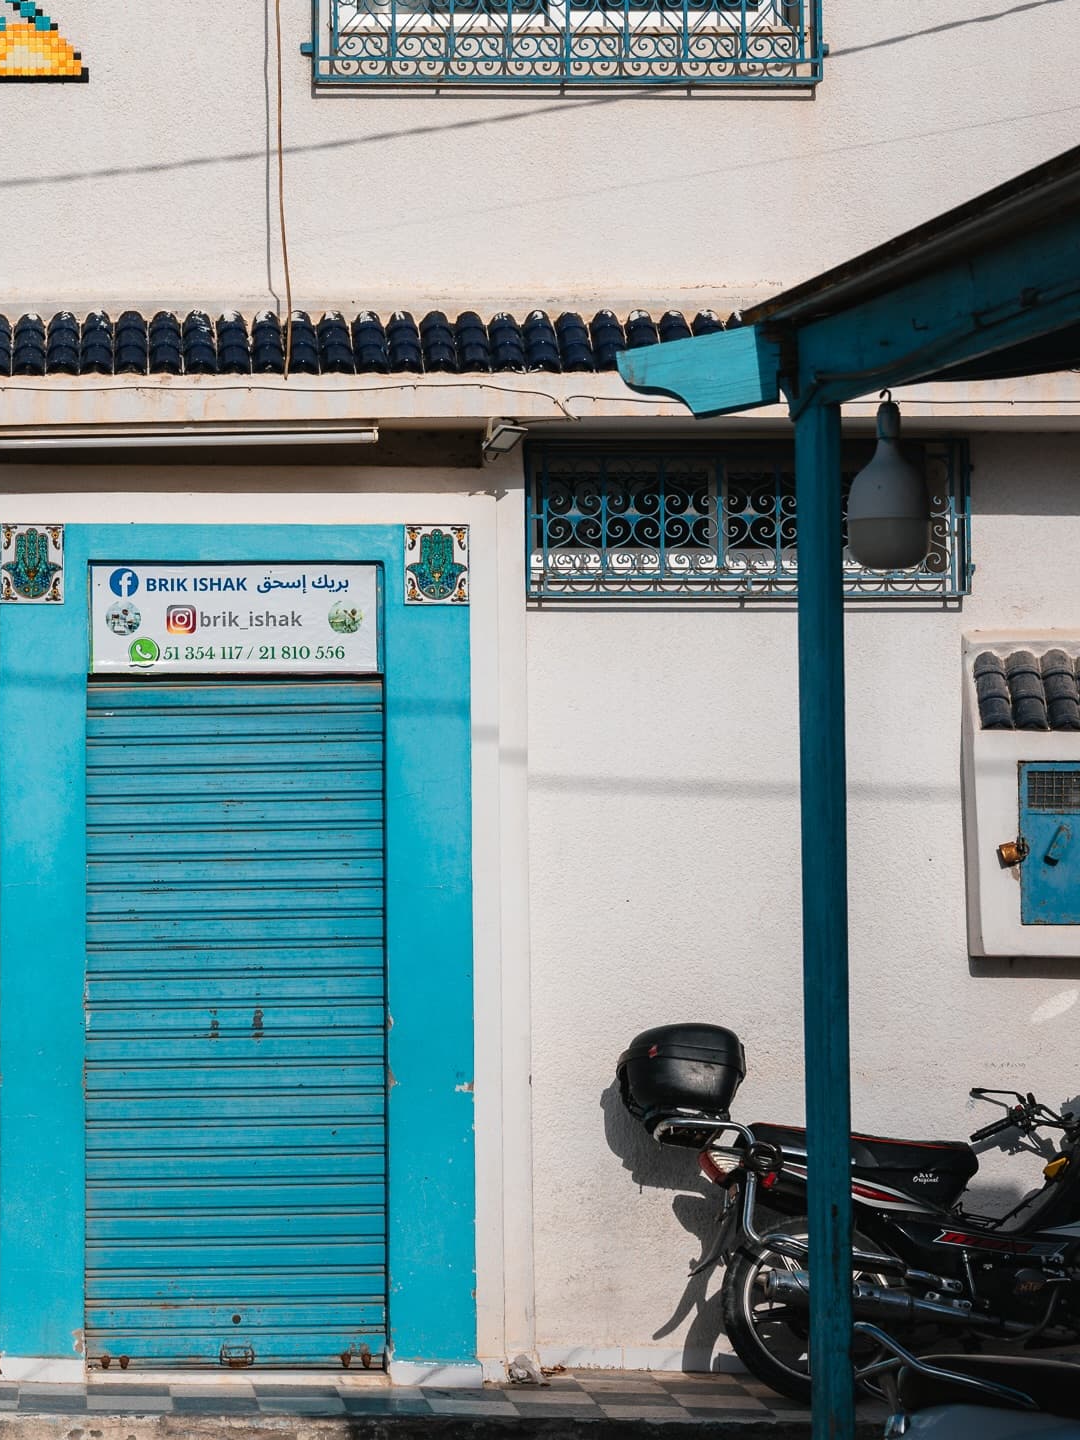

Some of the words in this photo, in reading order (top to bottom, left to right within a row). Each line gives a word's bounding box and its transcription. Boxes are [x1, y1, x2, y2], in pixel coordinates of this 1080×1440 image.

[146, 578, 188, 592] BRIK
[193, 577, 247, 592] ISHAK
[257, 574, 307, 594] إسحق
[311, 574, 349, 593] بريك
[199, 611, 303, 630] brik_ishak
[163, 646, 179, 661] 51
[184, 646, 216, 660] 354
[220, 646, 244, 660] 117
[259, 646, 276, 660] 21
[281, 646, 310, 660] 810
[315, 645, 345, 660] 556
